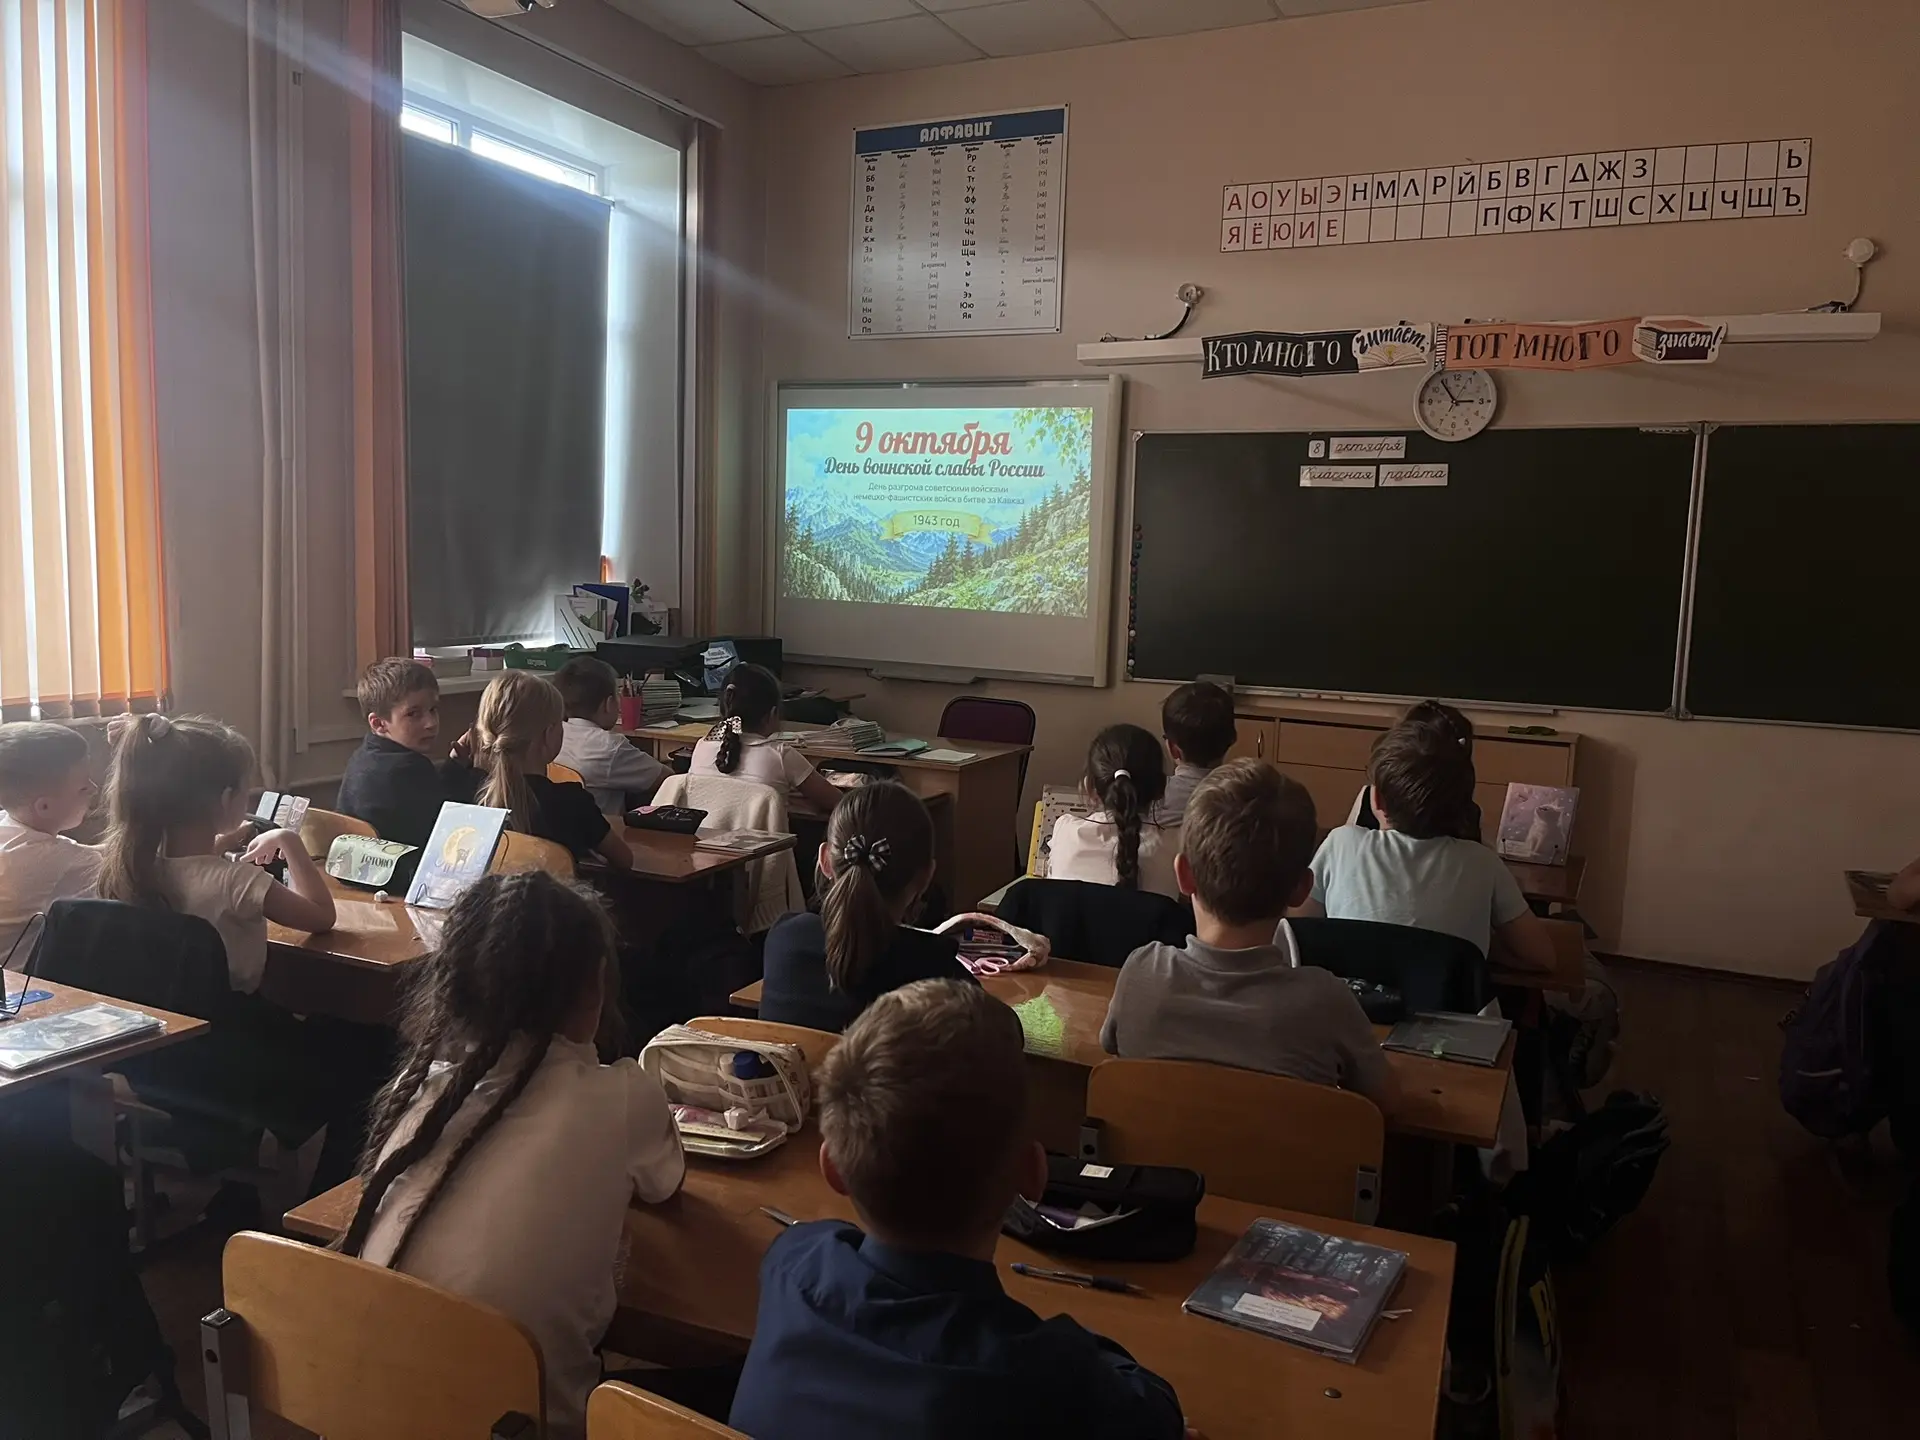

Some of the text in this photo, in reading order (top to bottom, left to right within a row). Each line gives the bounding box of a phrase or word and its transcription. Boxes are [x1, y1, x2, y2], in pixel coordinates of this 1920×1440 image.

[920, 122, 992, 142] АЛФАВИТ
[967, 153, 976, 161] Рр
[1227, 193, 1242, 211] А
[1252, 191, 1267, 209] О
[1277, 188, 1291, 207] У
[1300, 187, 1317, 205] Ы
[1326, 185, 1341, 203] Э
[1352, 182, 1368, 201] Н
[1376, 180, 1396, 199] М
[1432, 176, 1446, 195] Р
[1458, 172, 1475, 194] Й
[1488, 171, 1500, 190] Б
[1515, 168, 1530, 188] В
[1545, 166, 1558, 185] Г
[1597, 160, 1622, 180] Ж
[1632, 158, 1647, 178] З
[1787, 149, 1802, 169] Ь
[864, 204, 875, 213] Дд
[1228, 226, 1240, 244] Я
[1252, 222, 1262, 244] Ё
[1274, 222, 1291, 241] Ю
[1299, 221, 1314, 239] И
[1326, 219, 1338, 238] Е
[1483, 207, 1500, 227] П
[1507, 205, 1532, 224] Ф
[1540, 202, 1556, 222] К
[1569, 200, 1585, 219] Т
[1595, 198, 1618, 218] Ш
[1629, 196, 1645, 215] С
[1657, 193, 1676, 214] Х
[1721, 190, 1738, 209] Ч
[1782, 187, 1800, 207] Ъ
[1252, 340, 1341, 368] МНОГО
[1450, 332, 1508, 361] ТОТ
[1513, 329, 1619, 362] МНОГО
[855, 421, 1012, 464] 9 октября
[1313, 443, 1321, 454] 8
[824, 457, 1045, 478] День воинской славы России
[868, 483, 887, 491] День
[971, 485, 1008, 493] войсками
[854, 494, 933, 502] немецко-фашистских
[964, 495, 986, 503] битве
[913, 515, 960, 528] 1943 год
